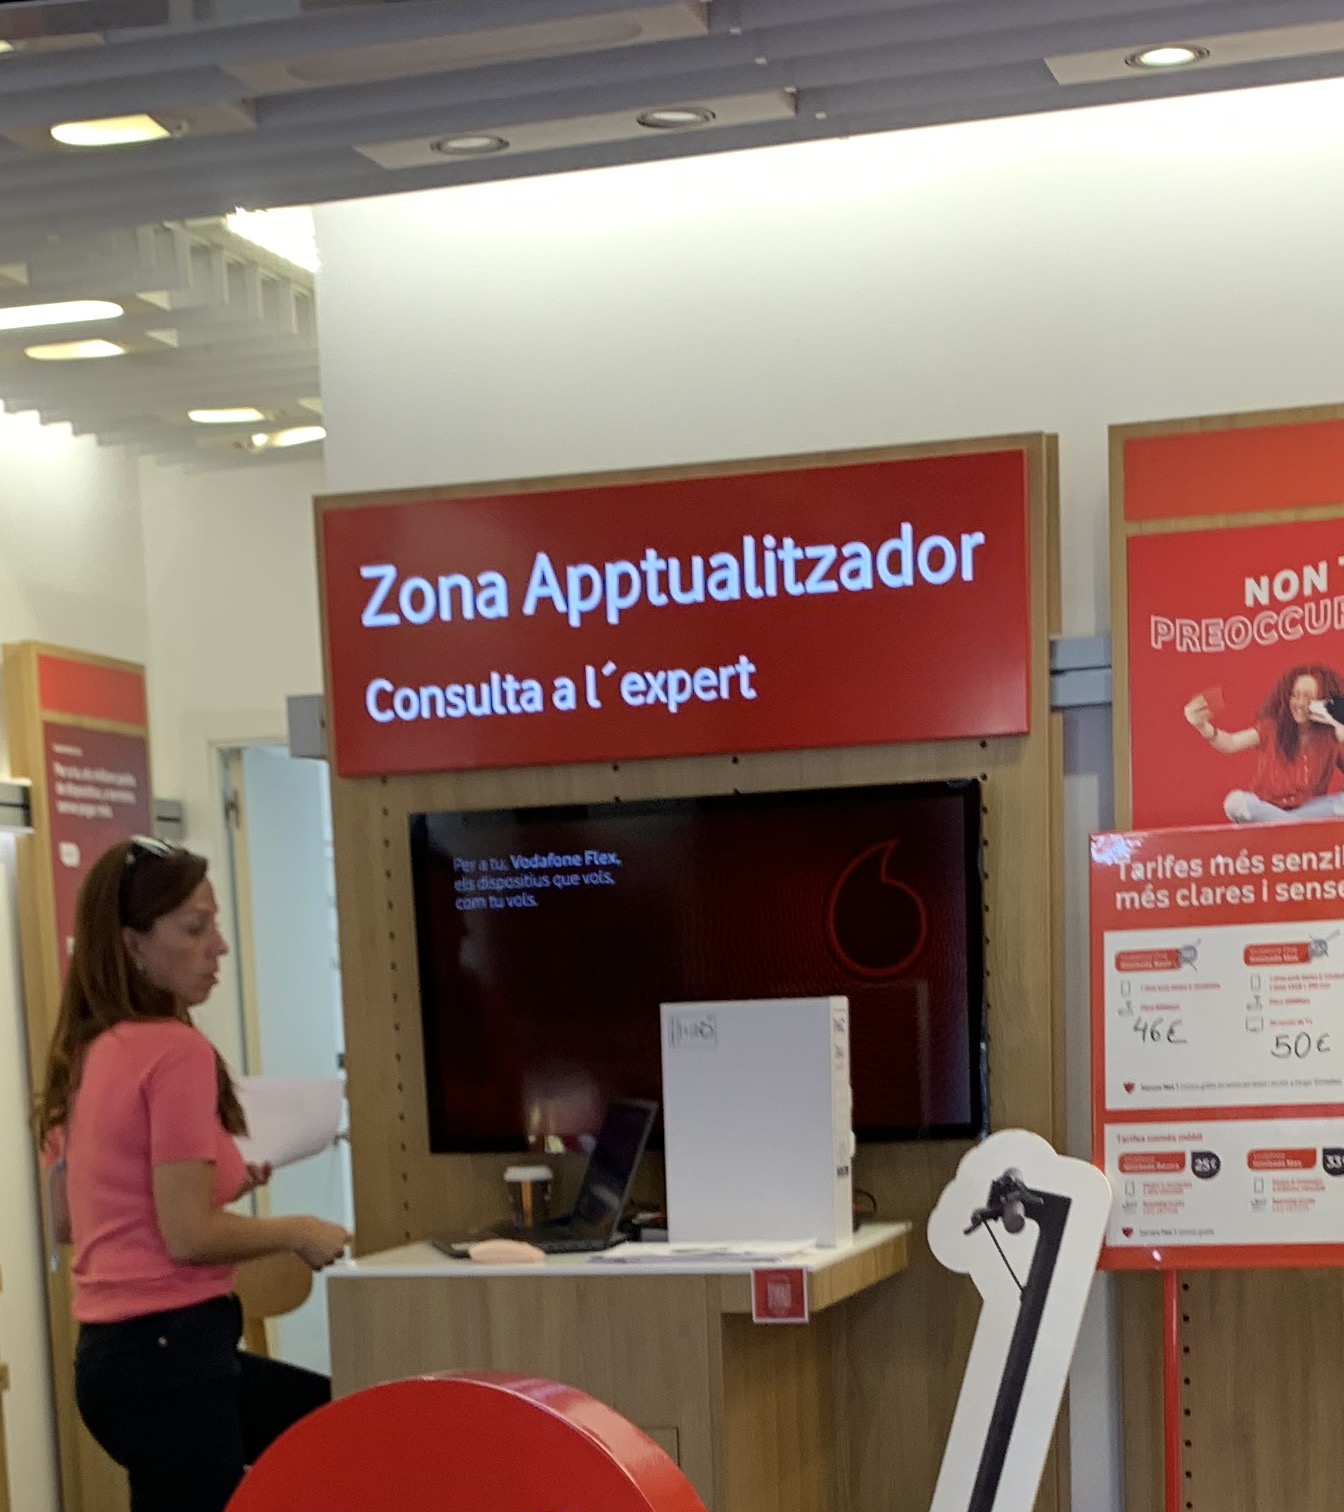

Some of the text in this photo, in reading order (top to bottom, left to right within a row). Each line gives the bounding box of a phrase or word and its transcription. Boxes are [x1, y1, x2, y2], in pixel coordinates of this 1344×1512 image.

[359, 523, 986, 628] Zona Apptualitzador
[1244, 560, 1328, 608] NON
[364, 670, 544, 723] Consulta
[551, 678, 577, 711] a
[510, 852, 583, 870] Vodafone
[1116, 854, 1204, 882] Tarifes
[1210, 849, 1265, 877] més
[476, 872, 551, 892] dispositius
[553, 874, 581, 890] que
[1115, 883, 1170, 911] més
[1175, 882, 1255, 908] clares
[1261, 878, 1269, 903] i
